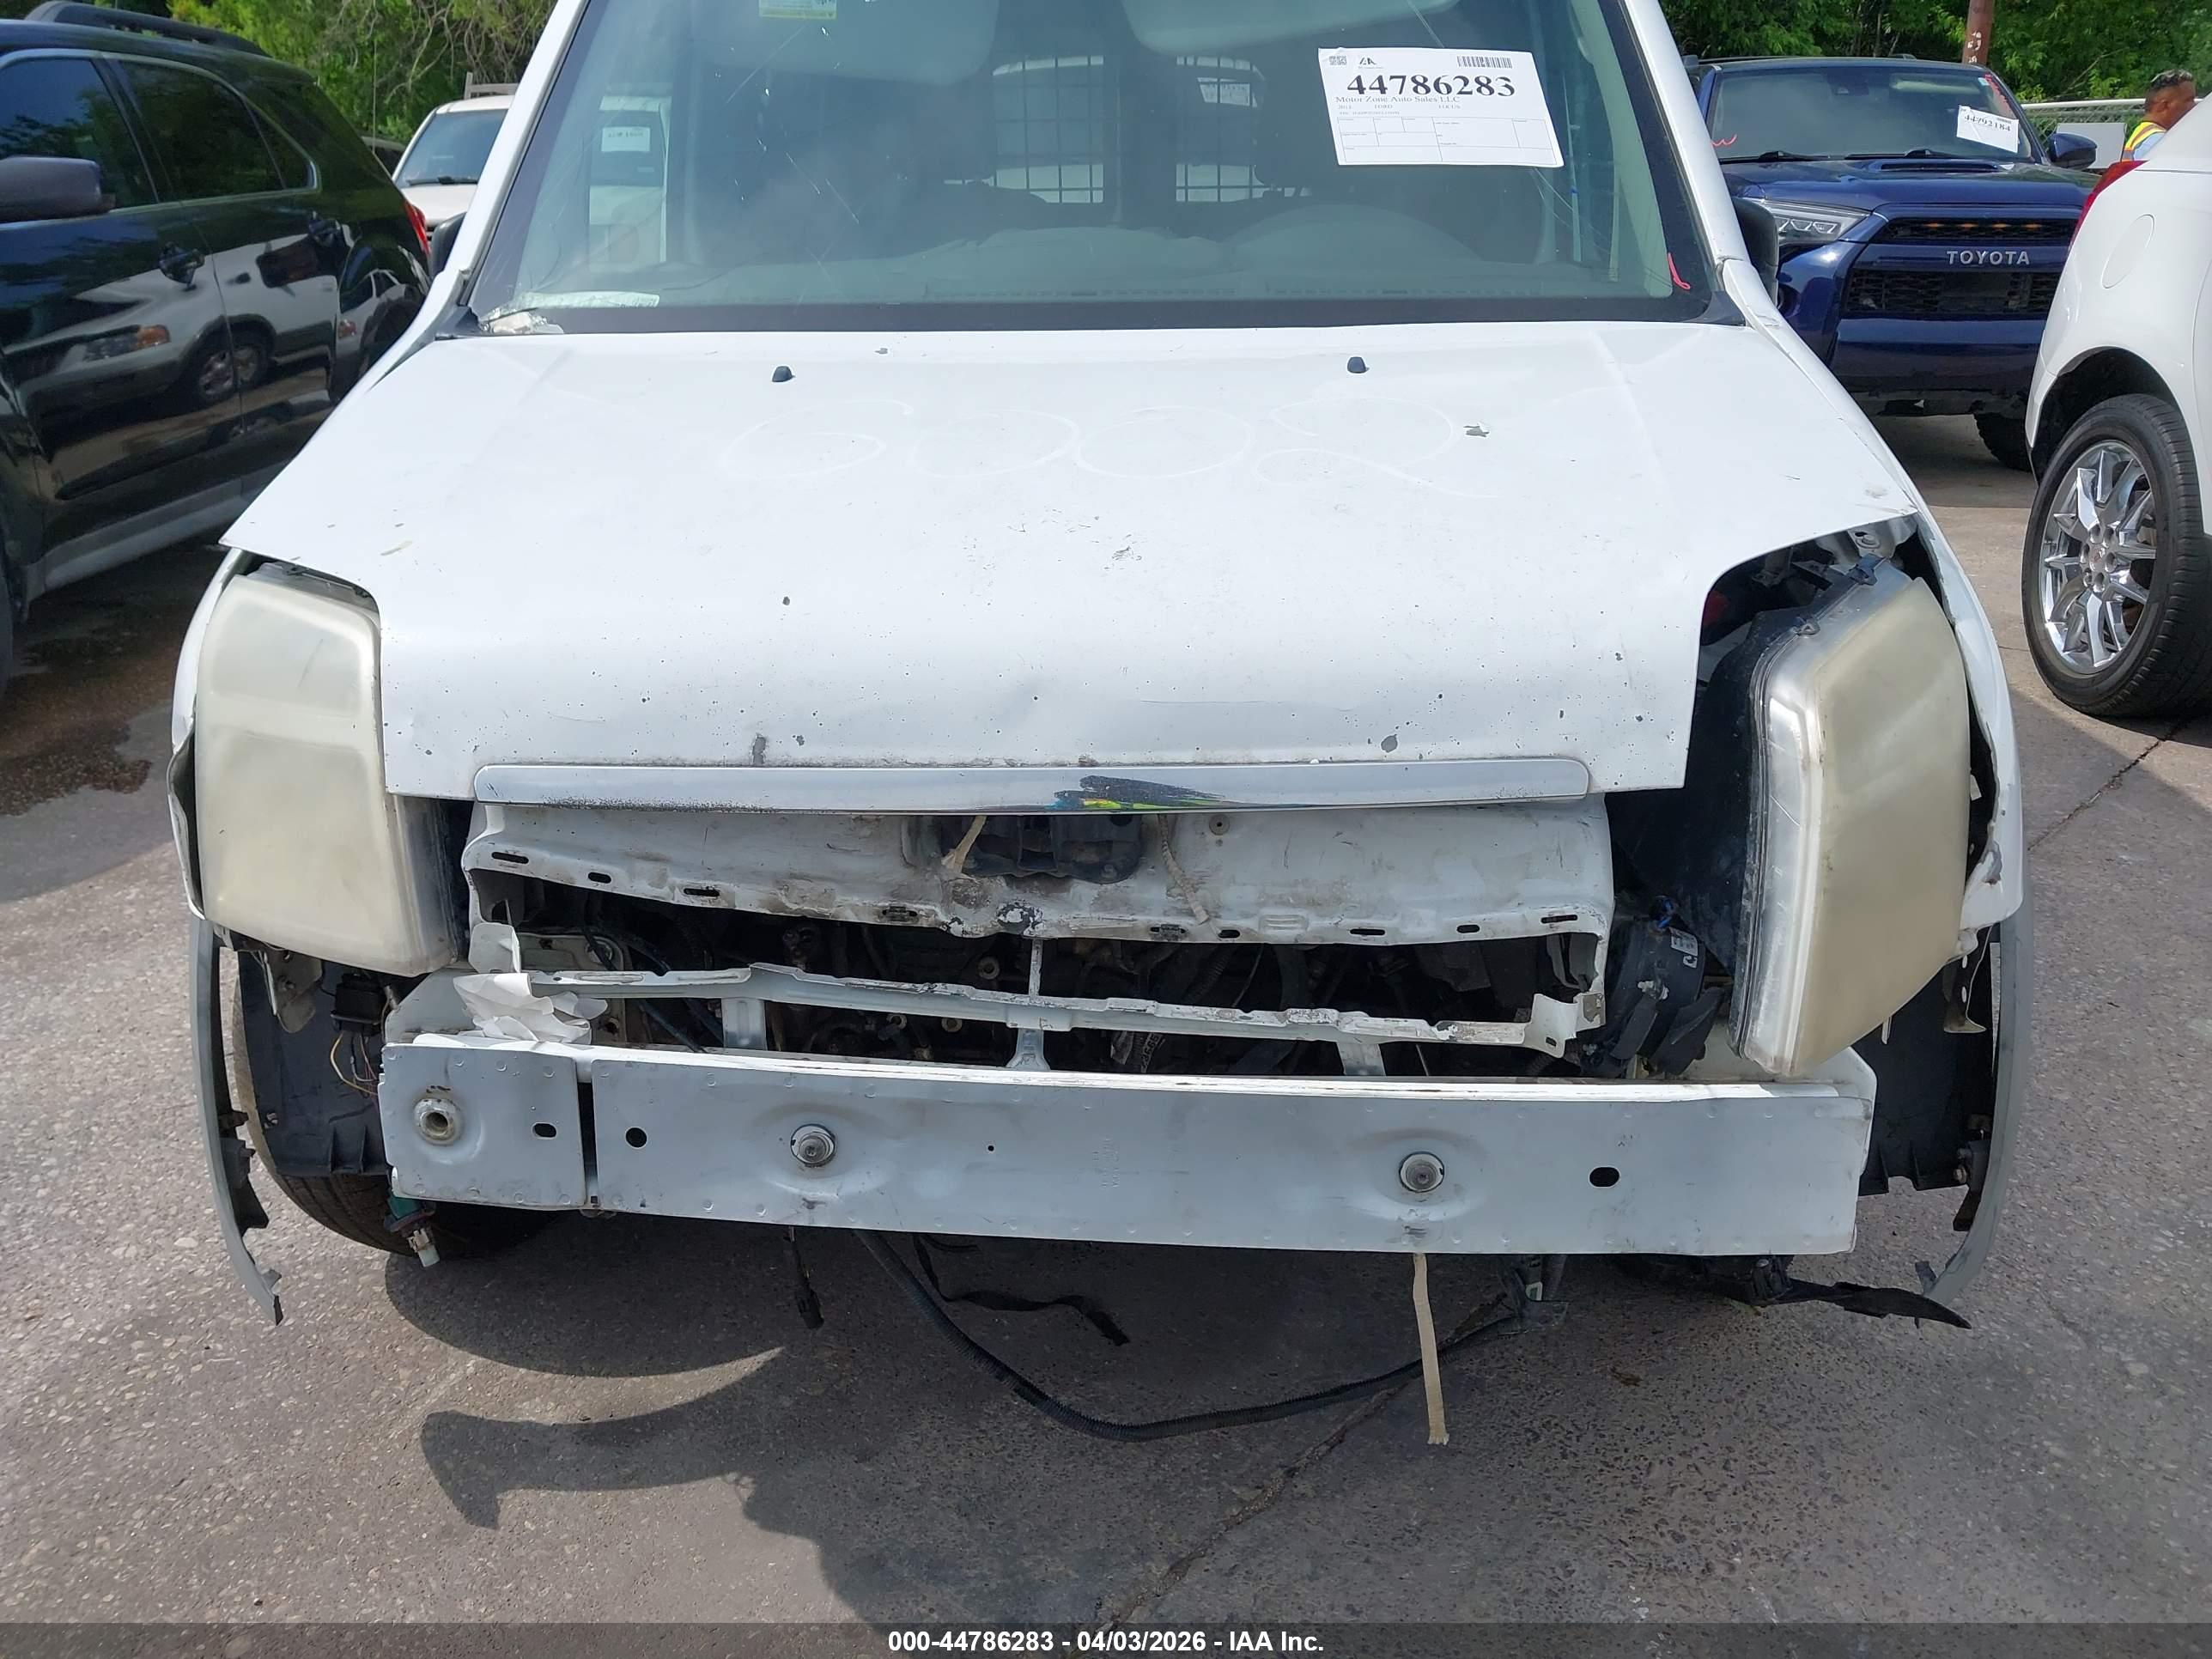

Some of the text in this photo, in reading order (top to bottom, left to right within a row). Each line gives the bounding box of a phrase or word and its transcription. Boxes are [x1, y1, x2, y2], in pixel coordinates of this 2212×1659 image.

[1347, 74, 1516, 97] 44786283
[1965, 114, 2011, 131] 44792184
[1947, 251, 2030, 265] TOYOTA
